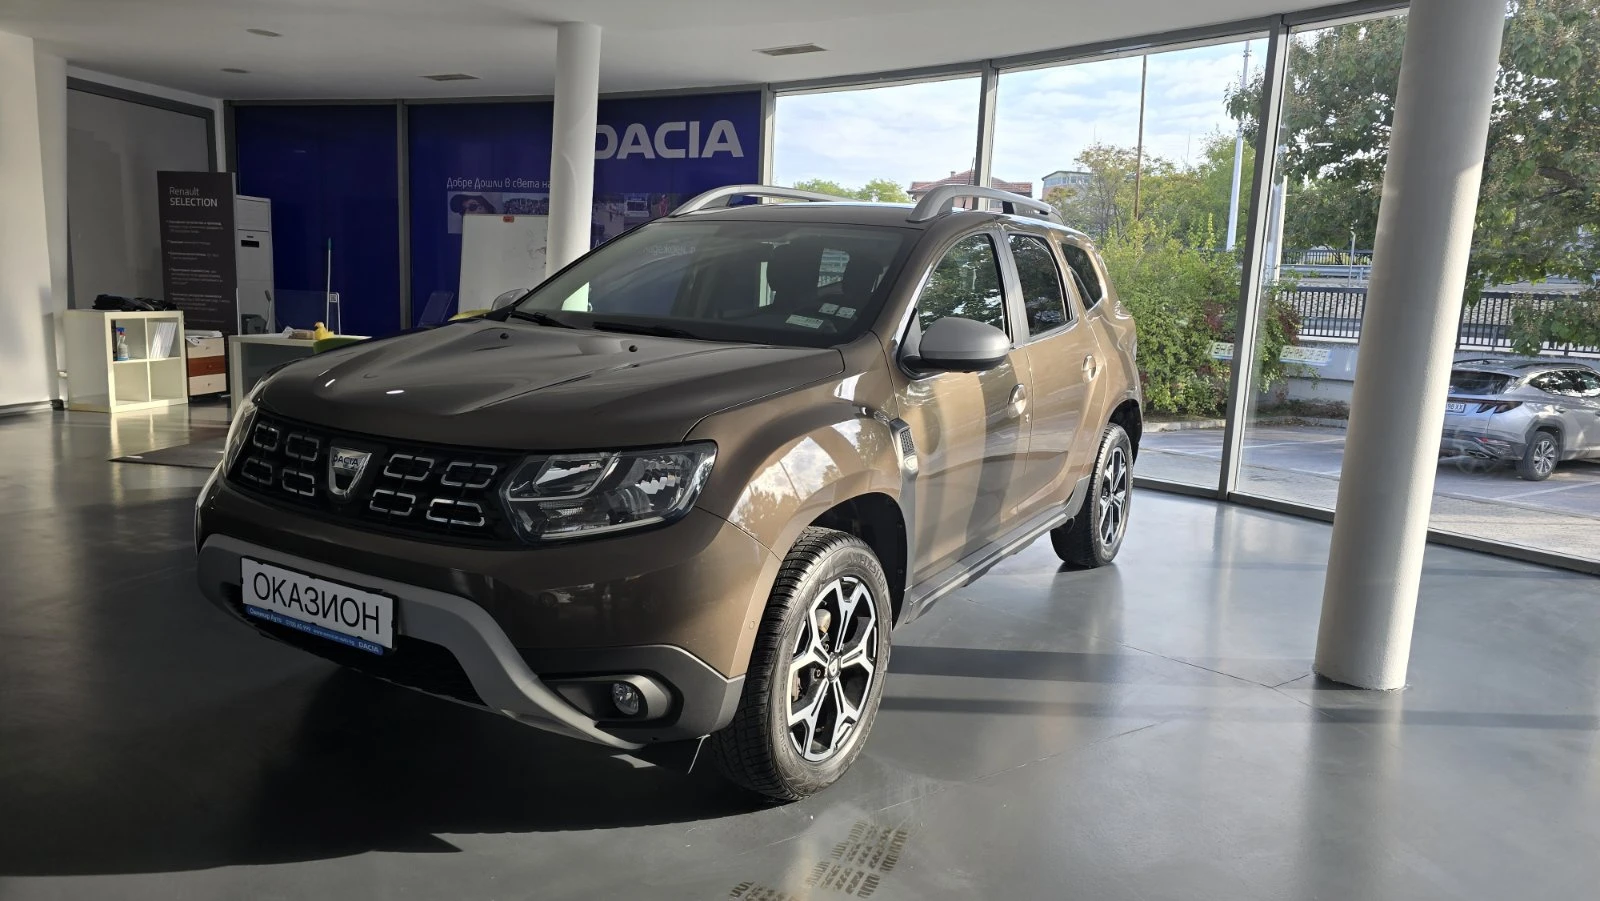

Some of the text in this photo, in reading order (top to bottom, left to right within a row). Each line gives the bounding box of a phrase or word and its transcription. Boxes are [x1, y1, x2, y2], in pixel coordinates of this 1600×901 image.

[595, 119, 744, 160] DACIA
[447, 177, 472, 190] Добре
[474, 177, 503, 190] Дошли
[513, 177, 539, 189] света
[169, 186, 200, 196] Renault
[170, 197, 218, 208] SELECTION
[332, 455, 358, 466] DACIA
[254, 572, 380, 635] ОКАЗИОН
[358, 641, 379, 653] DACIA
